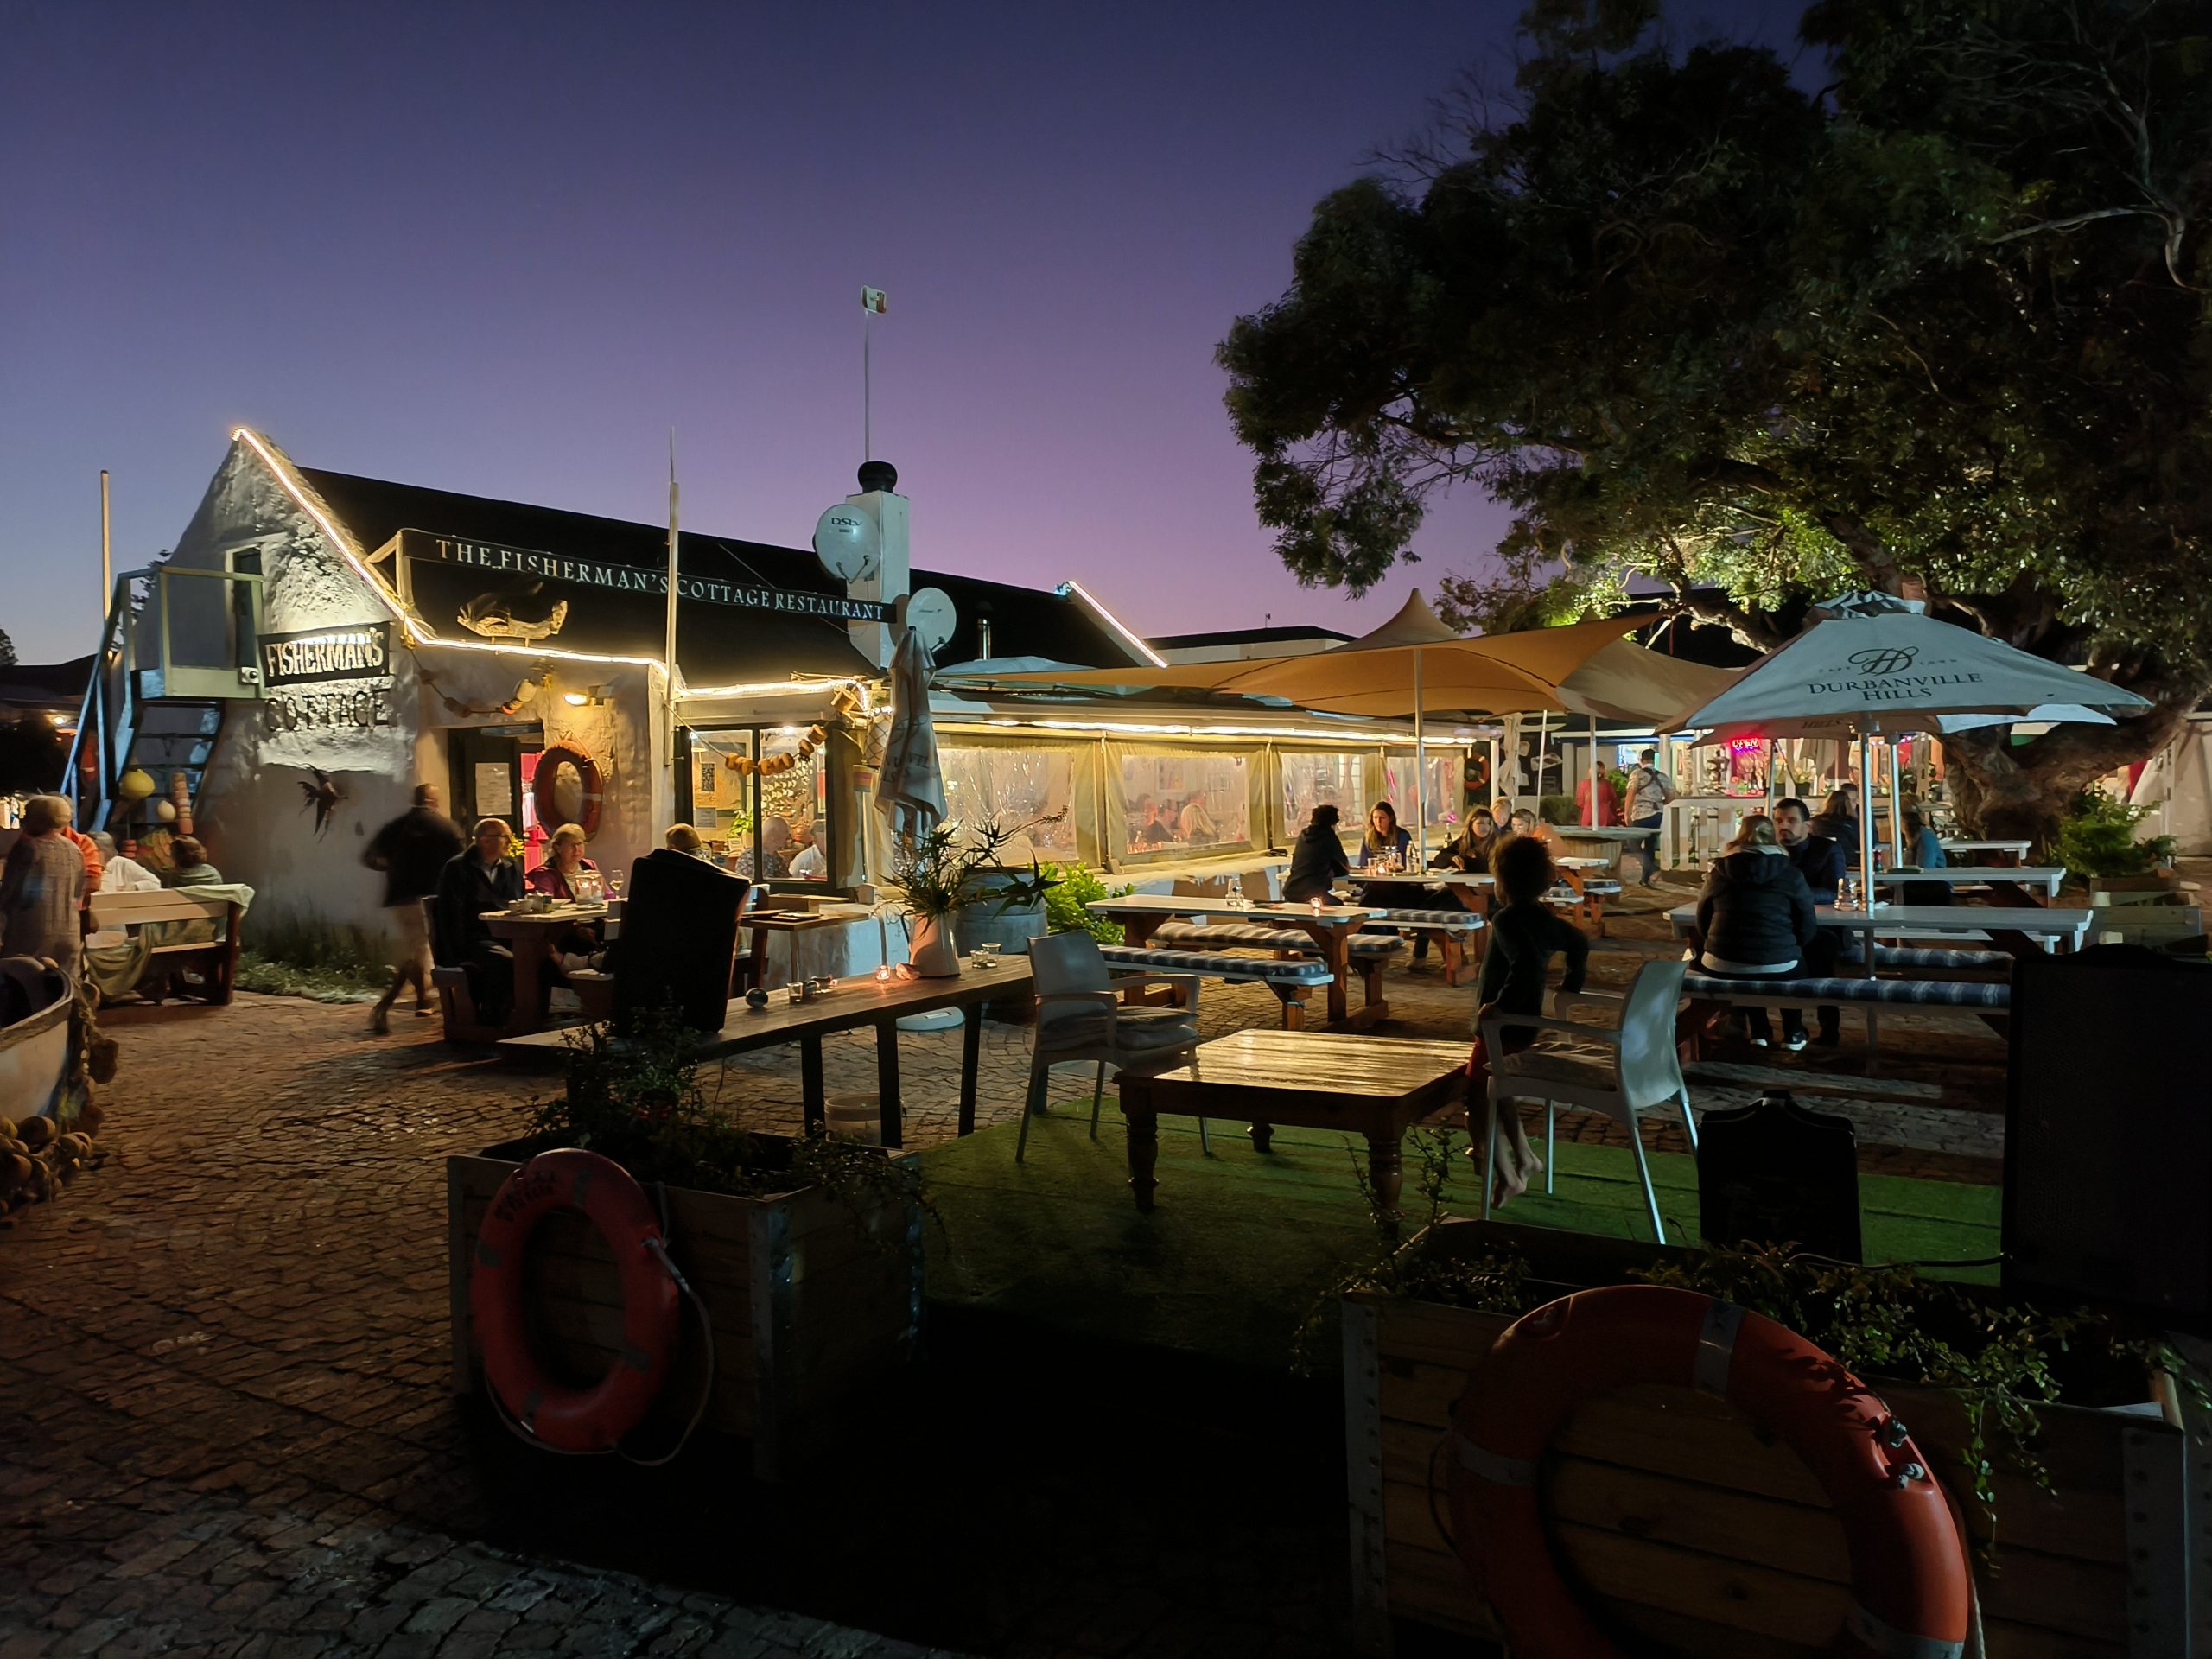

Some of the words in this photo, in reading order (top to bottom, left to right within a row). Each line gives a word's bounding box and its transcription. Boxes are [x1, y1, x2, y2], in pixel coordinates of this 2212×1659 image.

[435, 539, 492, 567] THE
[501, 549, 669, 594] FISHERMAN'S
[677, 578, 771, 608] COTTAGE
[774, 593, 885, 621] RESTAURANT
[264, 626, 385, 677] FISHERMAN'S
[1808, 672, 1984, 695] DURBANVILLE
[1862, 687, 1933, 702] HILLS
[264, 688, 391, 732] COTTAGE
